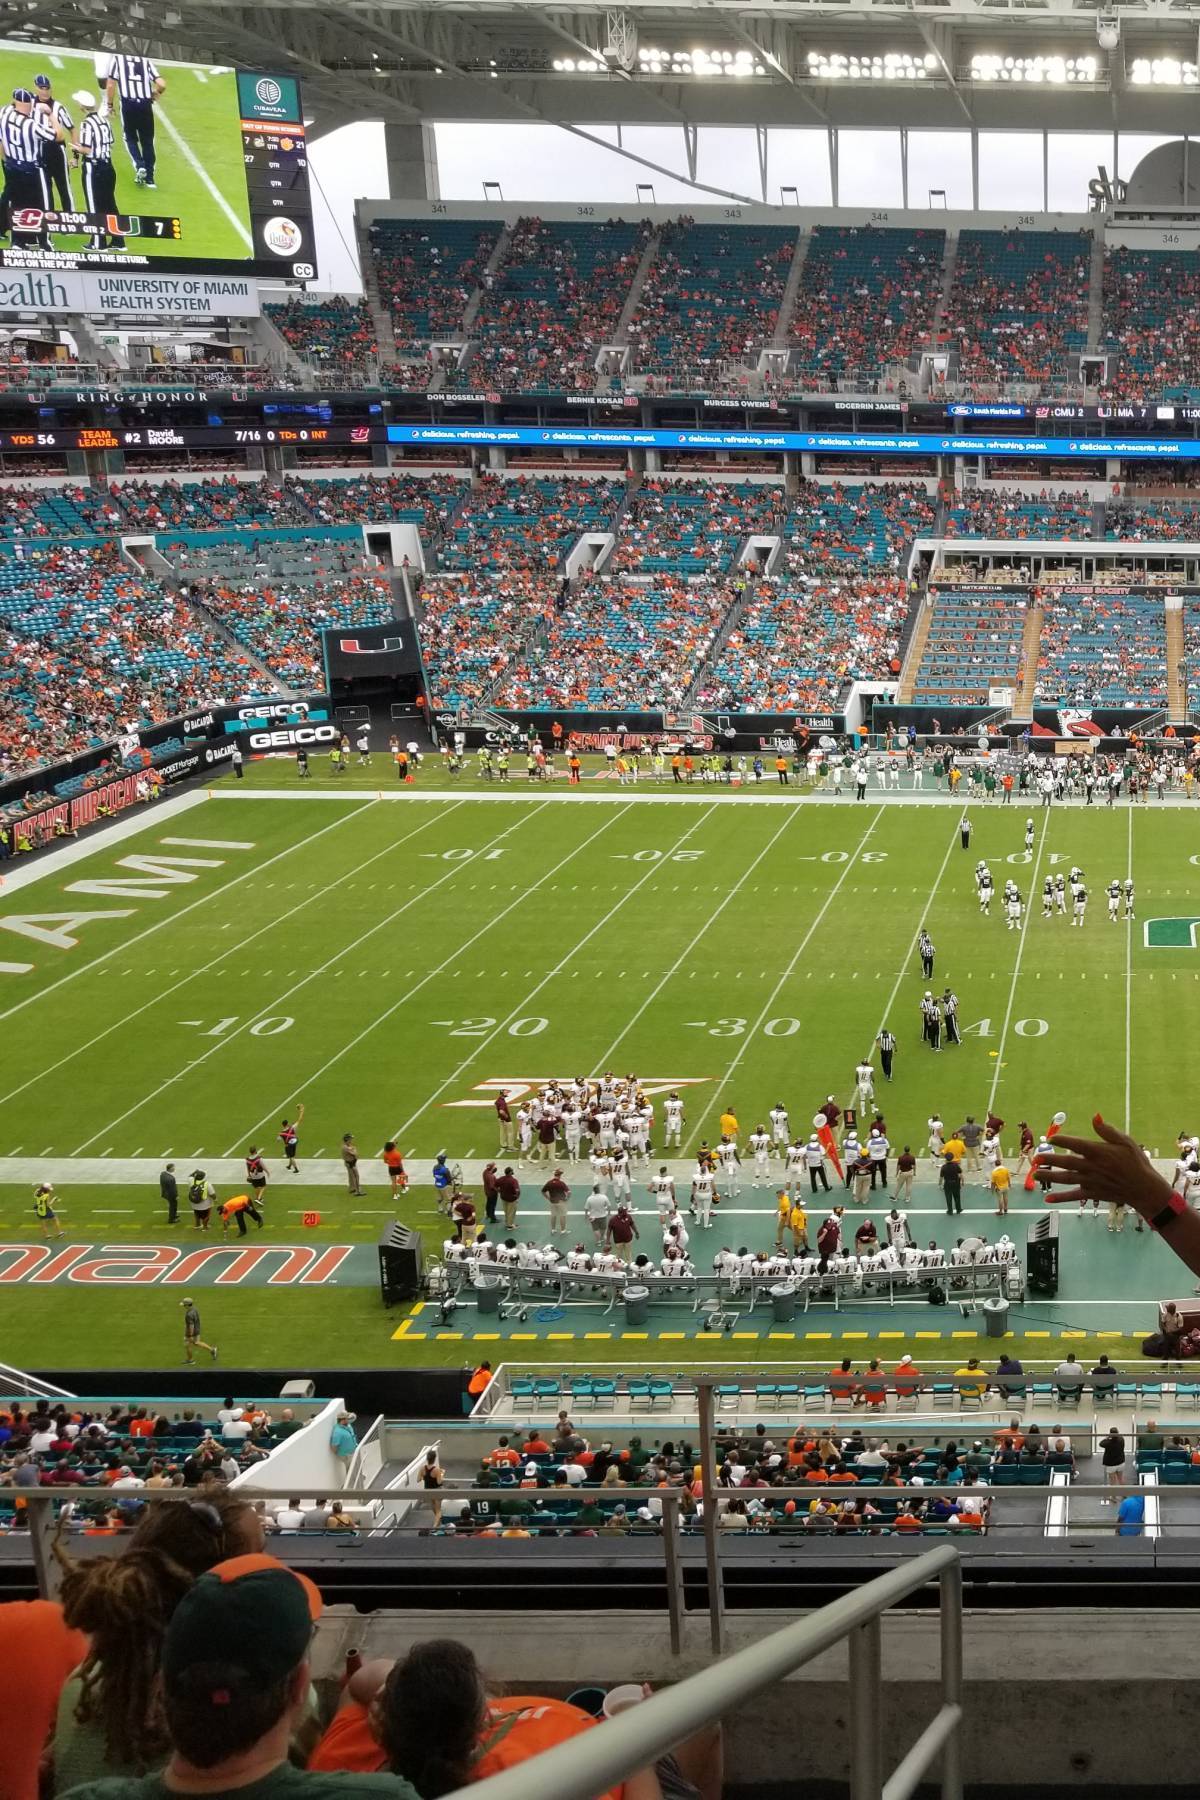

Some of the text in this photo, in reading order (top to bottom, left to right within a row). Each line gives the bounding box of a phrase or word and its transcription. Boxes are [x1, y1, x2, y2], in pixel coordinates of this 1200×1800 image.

[61, 213, 87, 223] 11:00
[155, 222, 164, 235] 7
[4, 259, 56, 268] FLAG ON THE
[45, 252, 87, 261] BRASWELL
[88, 254, 99, 262] ON
[100, 254, 117, 262] THE
[295, 266, 311, 276] CC
[98, 278, 249, 296] UNIVERSITY OF MIAMI
[100, 296, 211, 311] HEALTH SYSTEM
[77, 392, 208, 402] RING HONOR
[1054, 408, 1146, 417] CMU 2 MIA 7
[10, 436, 34, 444] YDS
[38, 434, 55, 444] 56
[81, 430, 112, 439] TEAM
[125, 432, 141, 443] #2
[235, 430, 260, 441] 7/16
[267, 430, 275, 440] 0
[279, 431, 297, 440] TDs
[300, 430, 308, 440] 0
[312, 430, 328, 439] INT
[78, 436, 184, 447] LEADER MOORE
[238, 702, 309, 720] GEICO
[250, 726, 335, 748] GEICO
[198, 1016, 296, 1036] 10
[448, 1017, 550, 1036] 20
[708, 1017, 801, 1037] 30
[962, 1017, 1050, 1038] 40
[303, 1213, 316, 1224] 20
